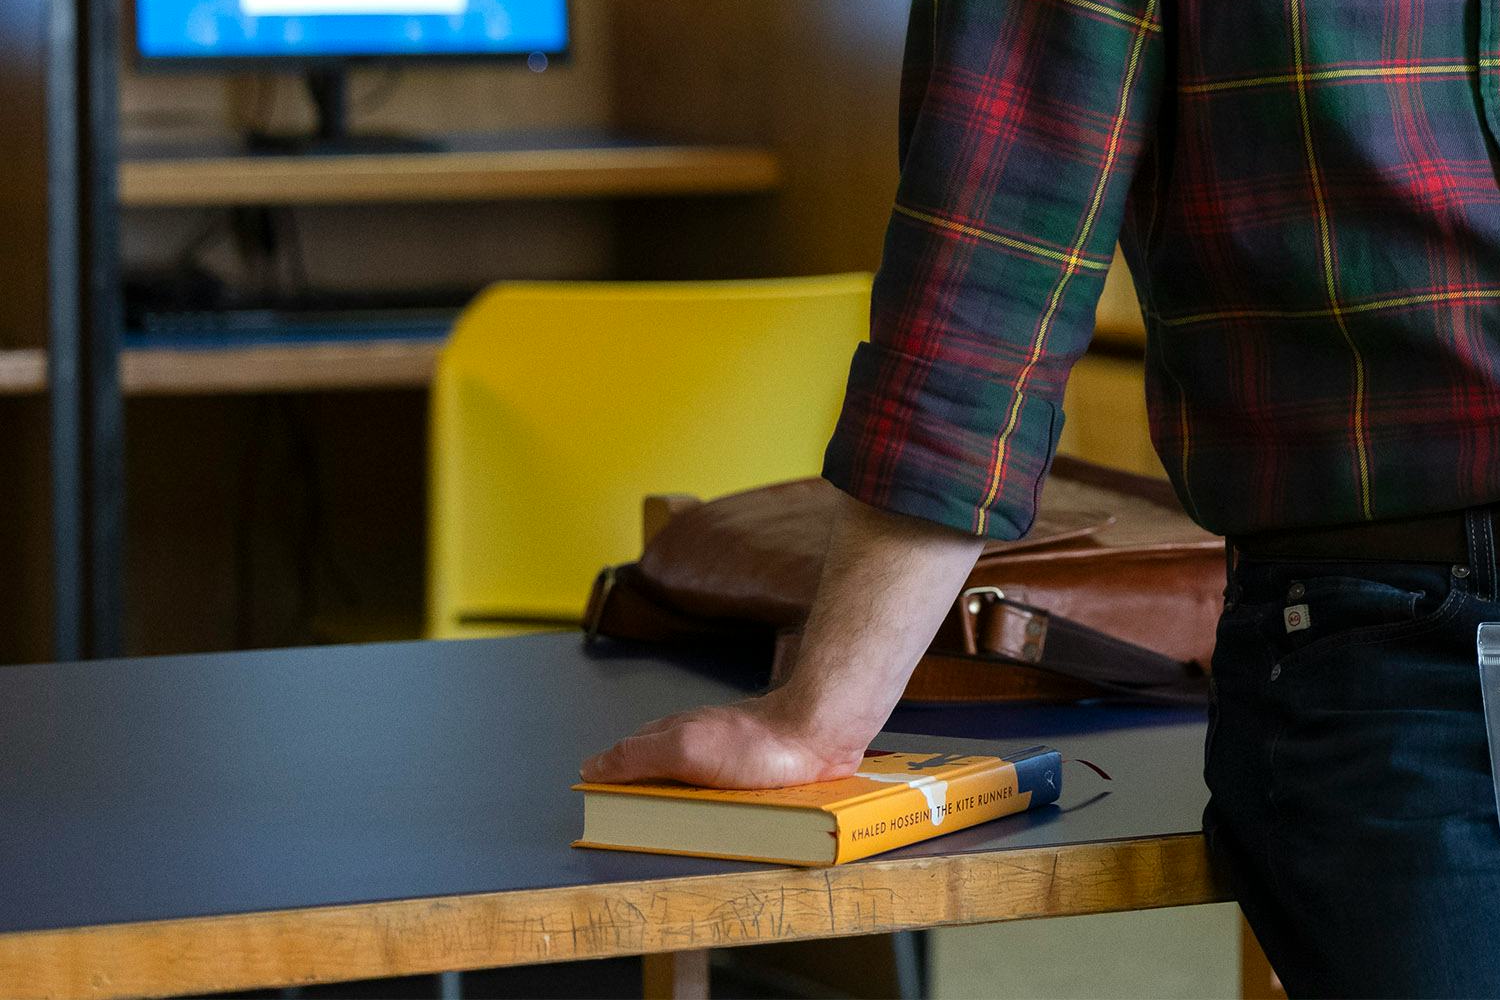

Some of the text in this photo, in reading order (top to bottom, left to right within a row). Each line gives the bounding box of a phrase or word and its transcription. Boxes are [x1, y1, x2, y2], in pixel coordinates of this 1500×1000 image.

[851, 822, 887, 841] KHALED
[936, 803, 953, 818] THE
[956, 796, 975, 812] KITE
[978, 786, 1013, 805] RUNNER
